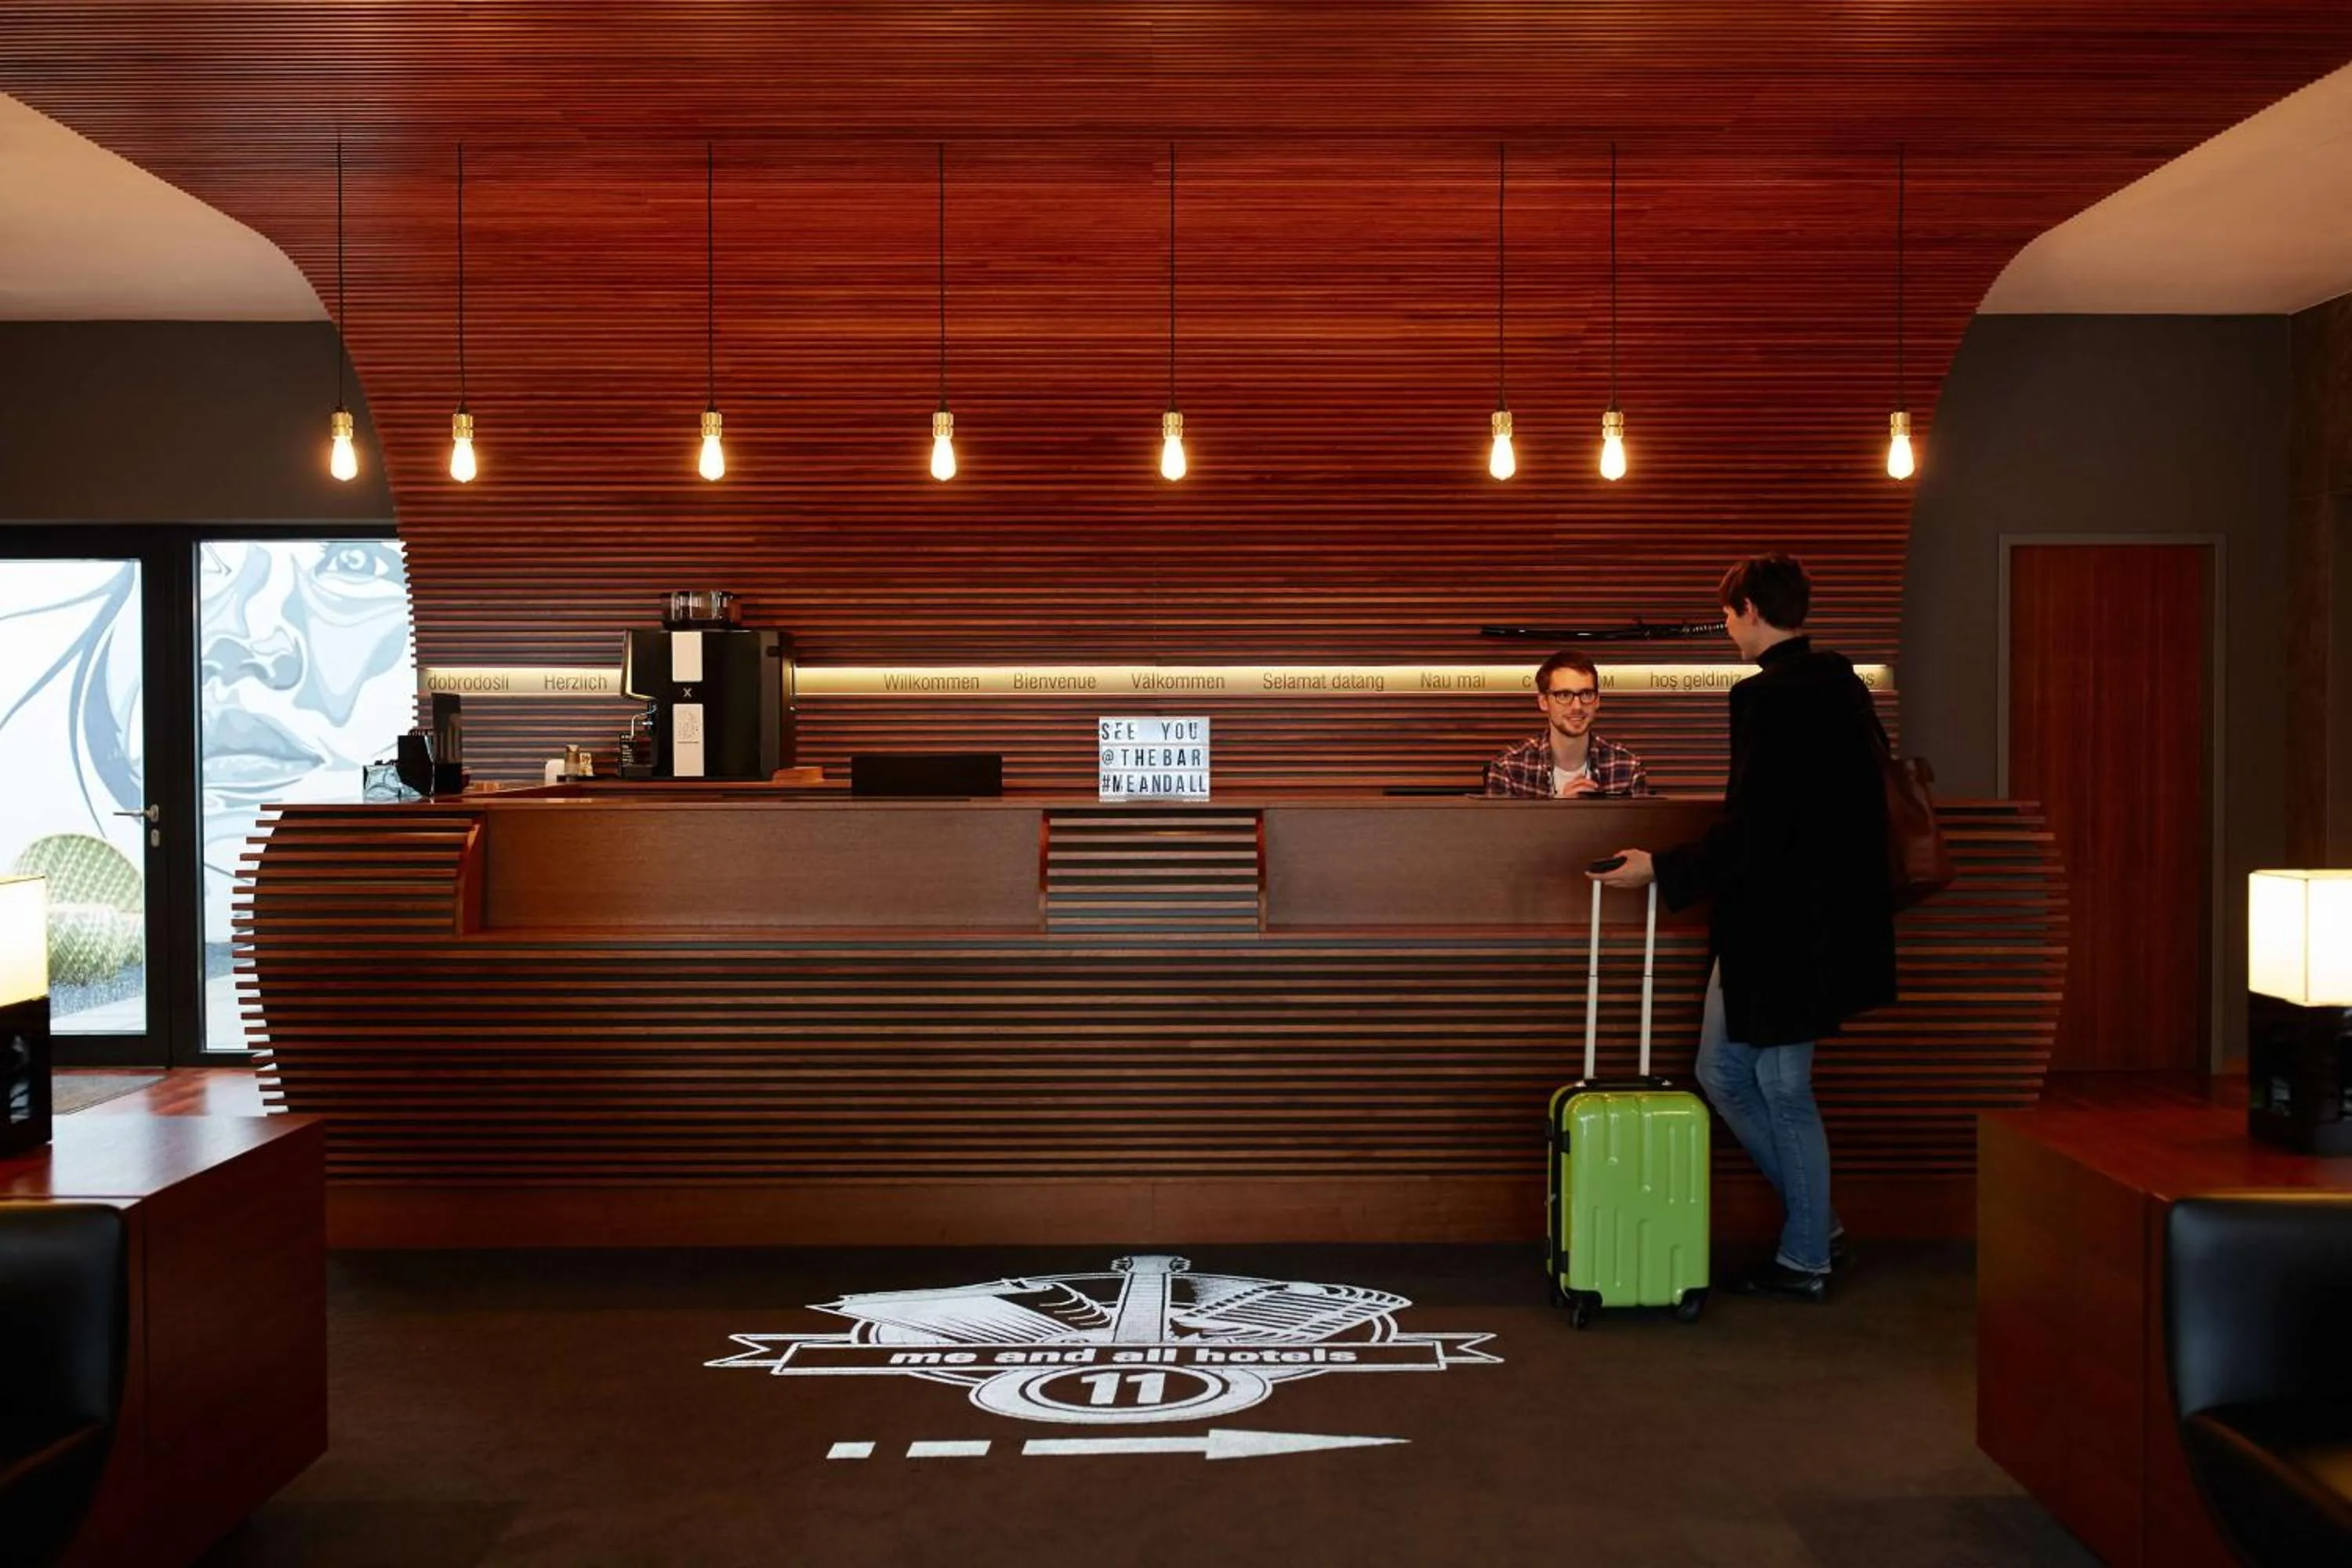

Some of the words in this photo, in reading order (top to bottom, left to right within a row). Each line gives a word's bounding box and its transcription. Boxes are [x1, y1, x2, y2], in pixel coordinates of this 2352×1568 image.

[544, 673, 608, 691] Herzlich
[884, 673, 979, 691] Willkommen
[1013, 672, 1096, 689] Bienvenue
[1263, 672, 1327, 689] Selamat
[1332, 672, 1384, 691] datang
[1420, 672, 1451, 688] Nau
[1457, 672, 1486, 688] mai
[1102, 722, 1135, 740] SEE
[1161, 722, 1198, 740] YOU
[1102, 749, 1201, 766] @THEBAR
[1102, 774, 1207, 793] #MEANDALL
[889, 1352, 977, 1365] me
[994, 1348, 1097, 1364] and
[1112, 1348, 1178, 1363] all
[1195, 1347, 1358, 1363] hotels
[1080, 1372, 1166, 1405] 11
